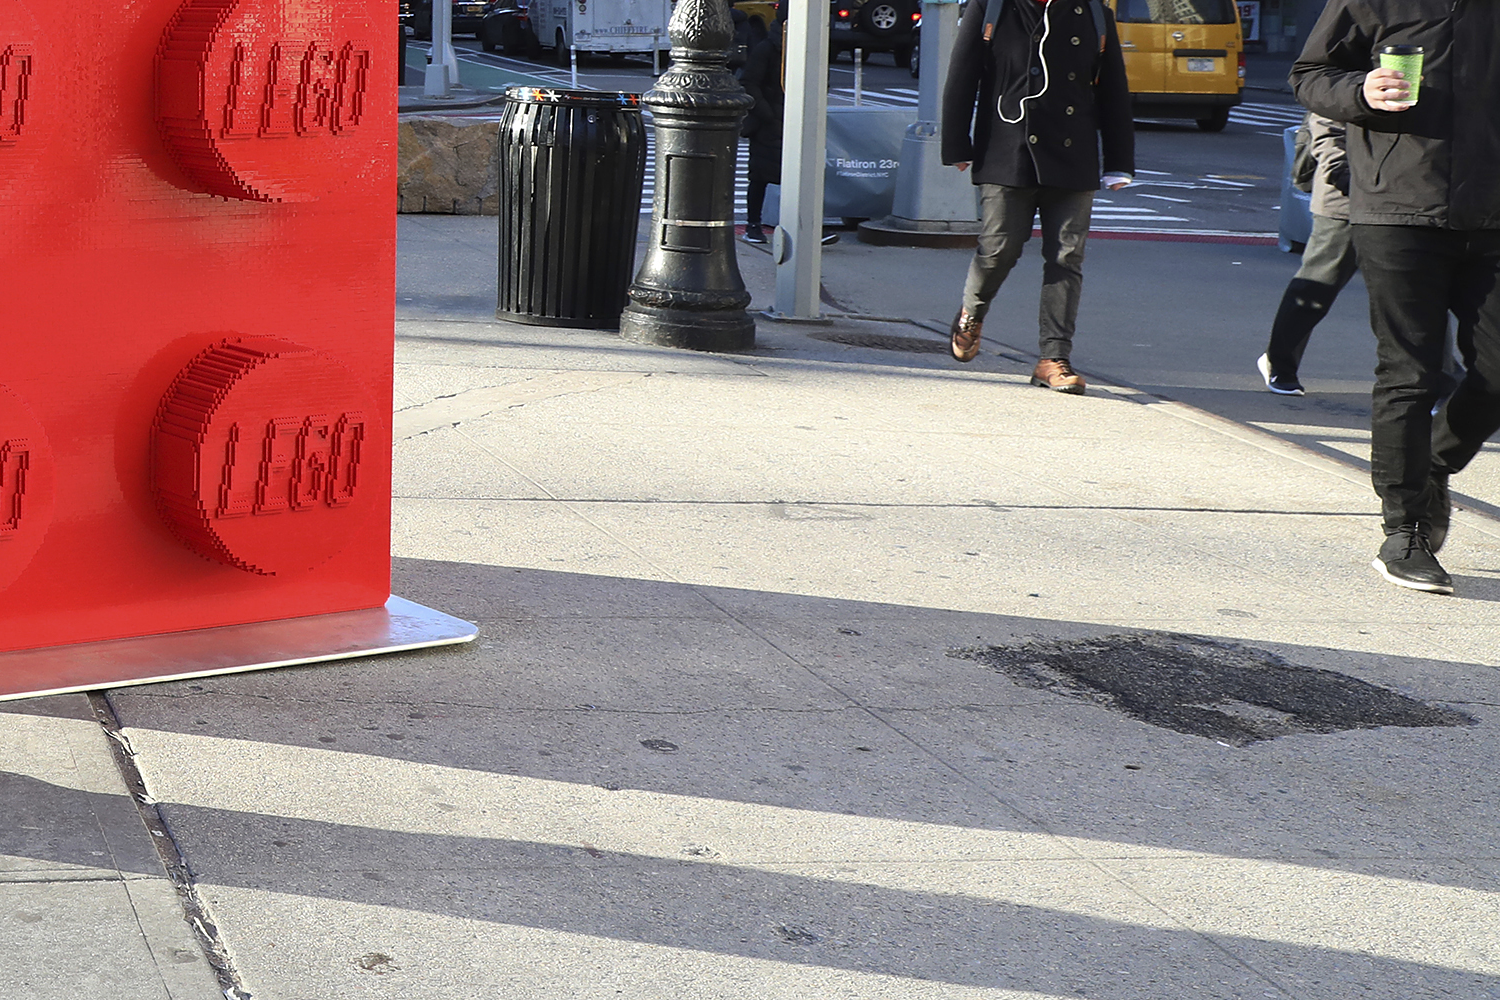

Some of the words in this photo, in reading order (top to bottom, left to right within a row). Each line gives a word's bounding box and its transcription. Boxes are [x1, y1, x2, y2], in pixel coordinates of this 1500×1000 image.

[220, 40, 370, 140] LEGO
[836, 158, 876, 169] Flatiron
[879, 159, 899, 169] 23r
[216, 410, 365, 519] LEGO
